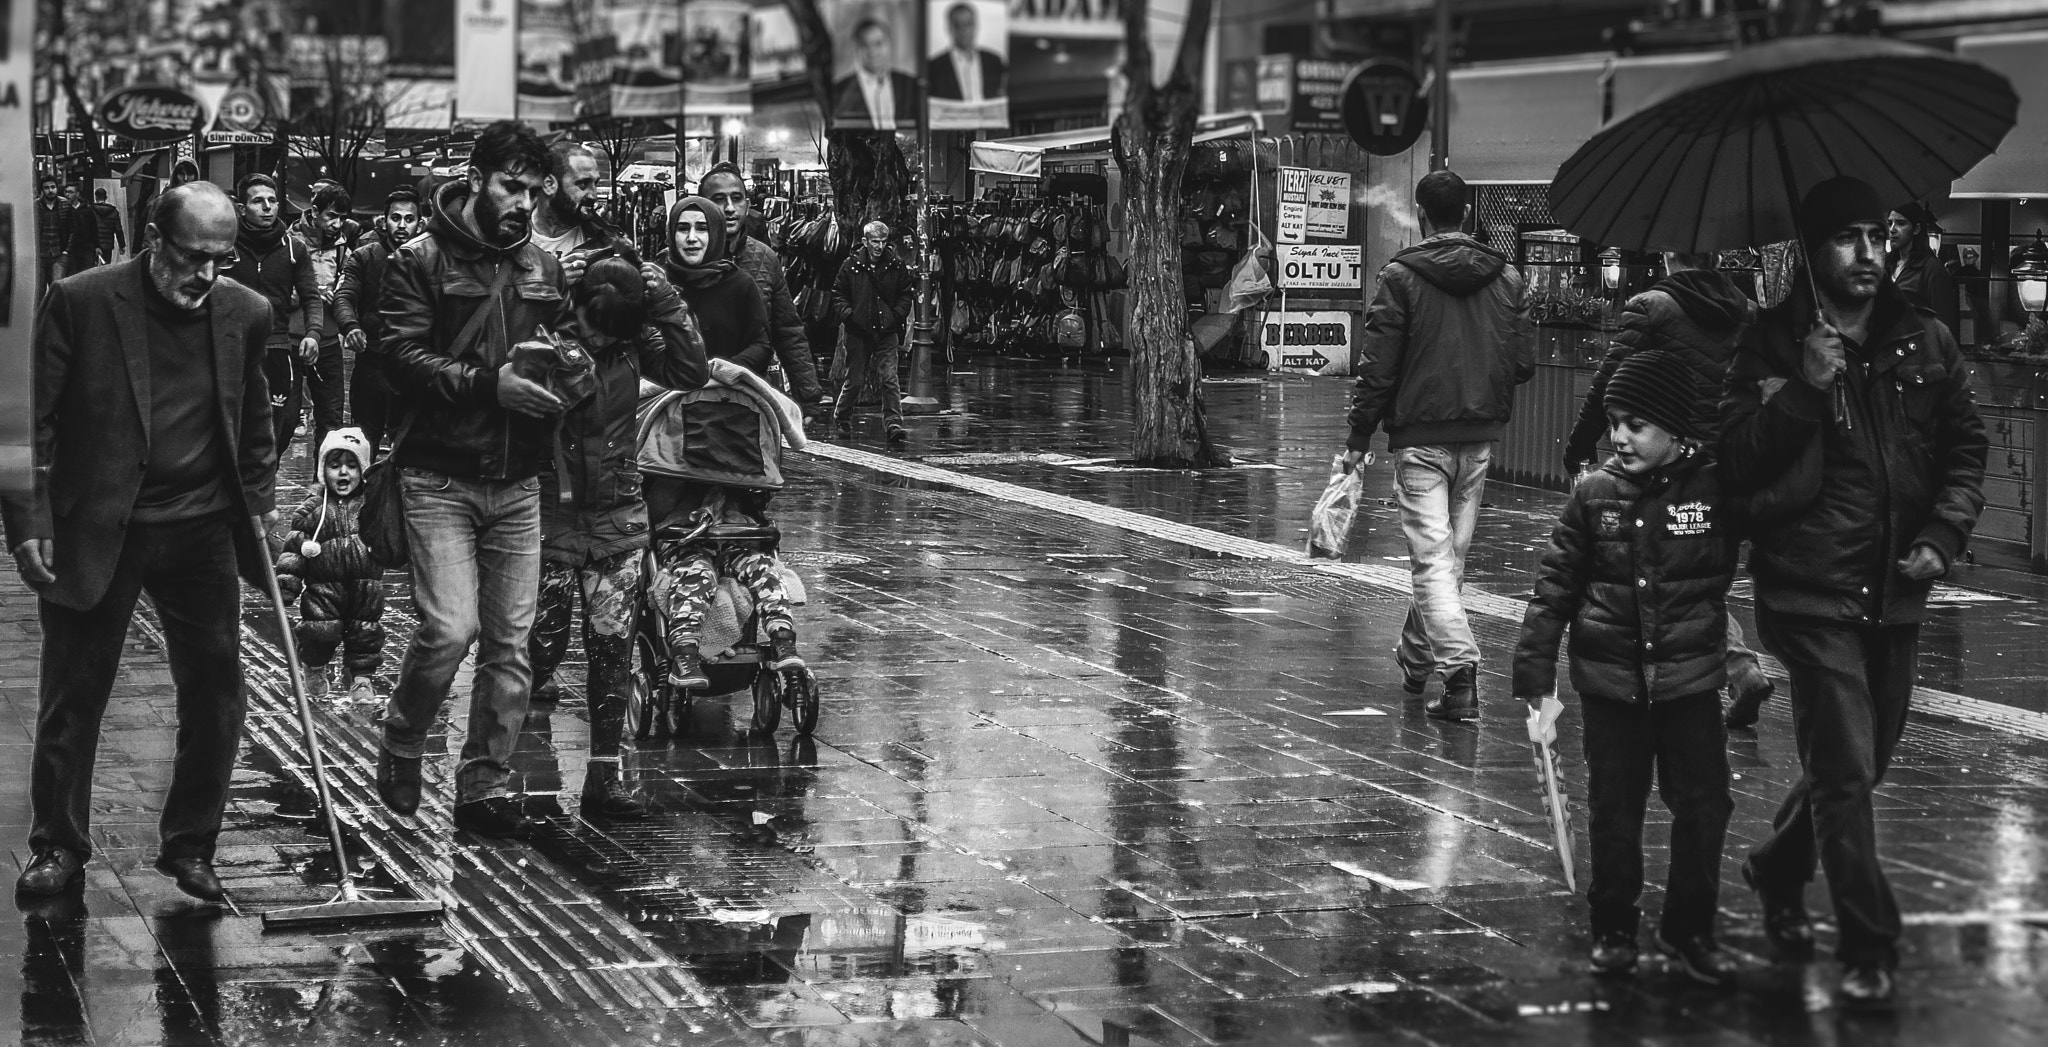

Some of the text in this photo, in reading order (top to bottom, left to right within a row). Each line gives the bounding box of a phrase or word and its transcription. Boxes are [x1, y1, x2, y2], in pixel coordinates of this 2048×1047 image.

[1309, 174, 1348, 186] VELVET
[1290, 246, 1318, 258] Siyah
[1285, 262, 1341, 279] OLTU
[1265, 322, 1347, 346] BERBER
[1284, 358, 1326, 366] ALT KAT
[1675, 511, 1704, 523] 1978
